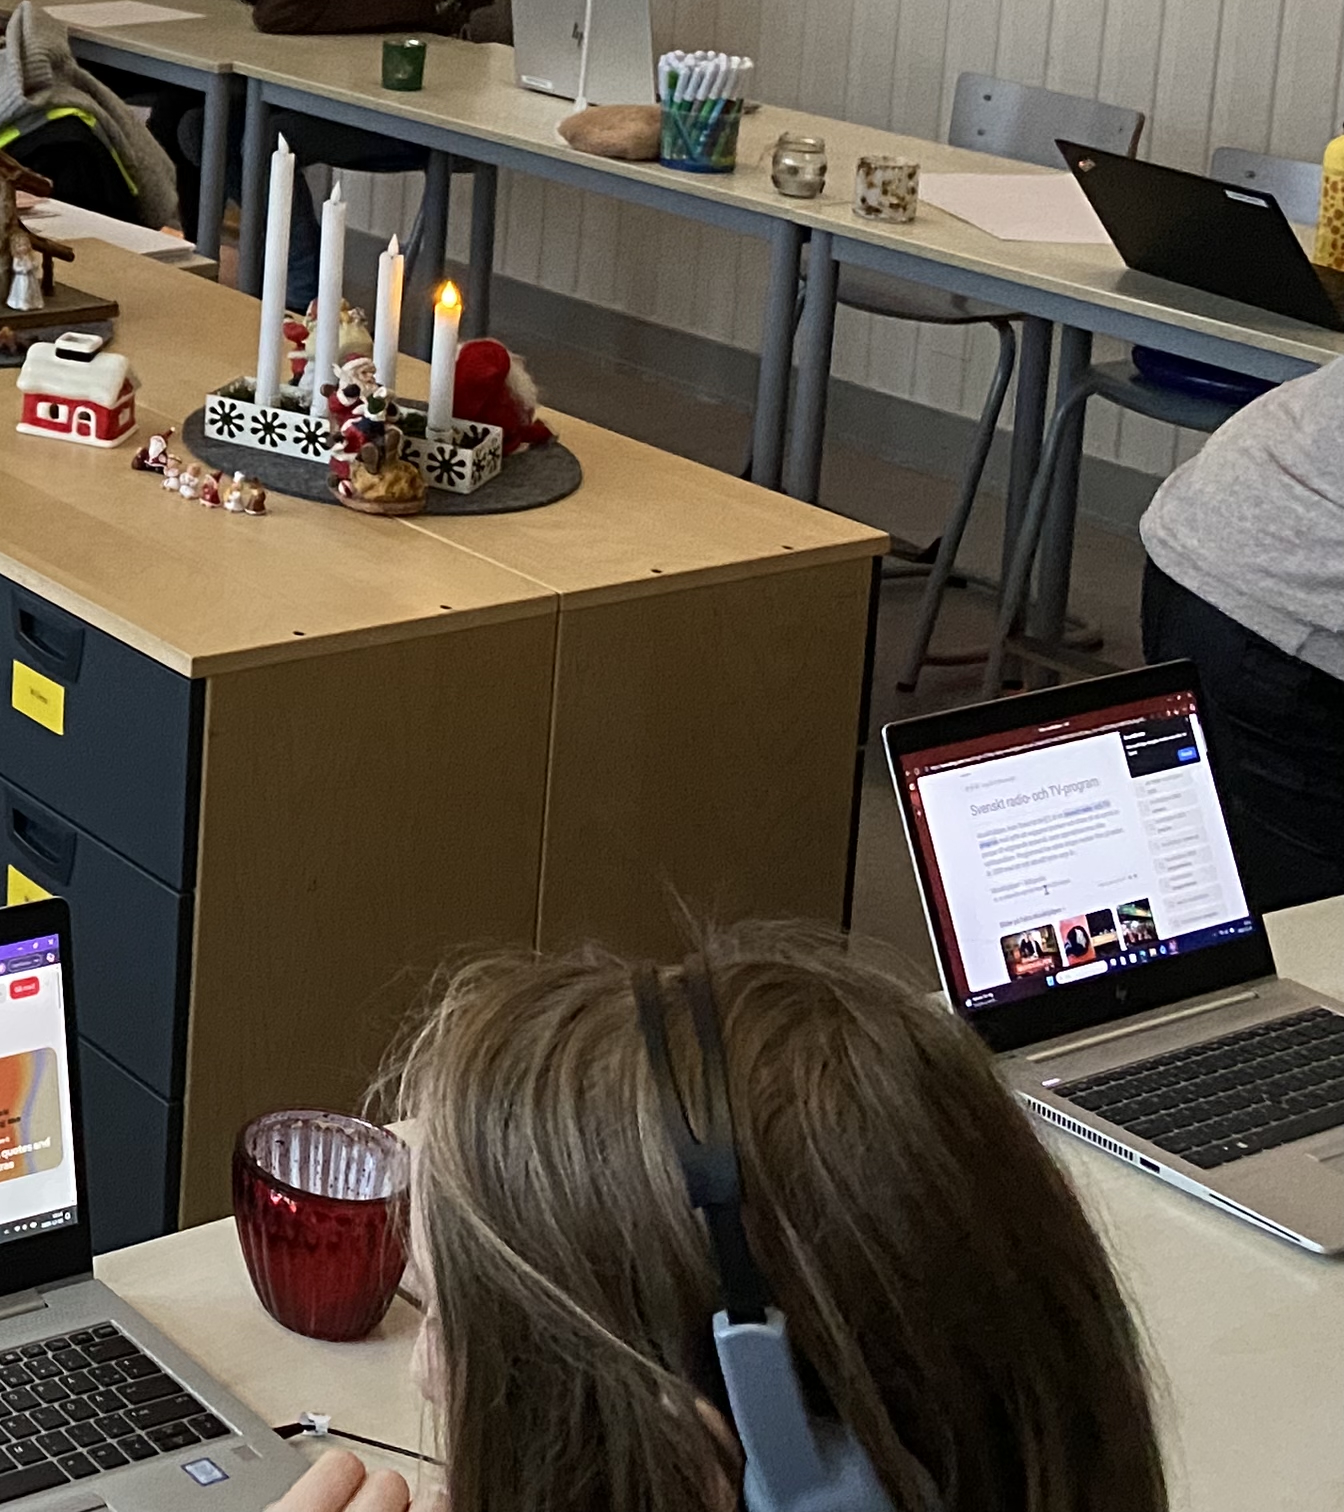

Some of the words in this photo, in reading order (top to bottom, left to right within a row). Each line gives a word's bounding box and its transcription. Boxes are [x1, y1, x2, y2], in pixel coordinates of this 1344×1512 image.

[970, 795, 1005, 817] Svenskt
[1032, 787, 1049, 803] och
[1049, 775, 1100, 802] TV-program
[1, 1142, 33, 1160] quotes
[32, 1136, 51, 1152] and
